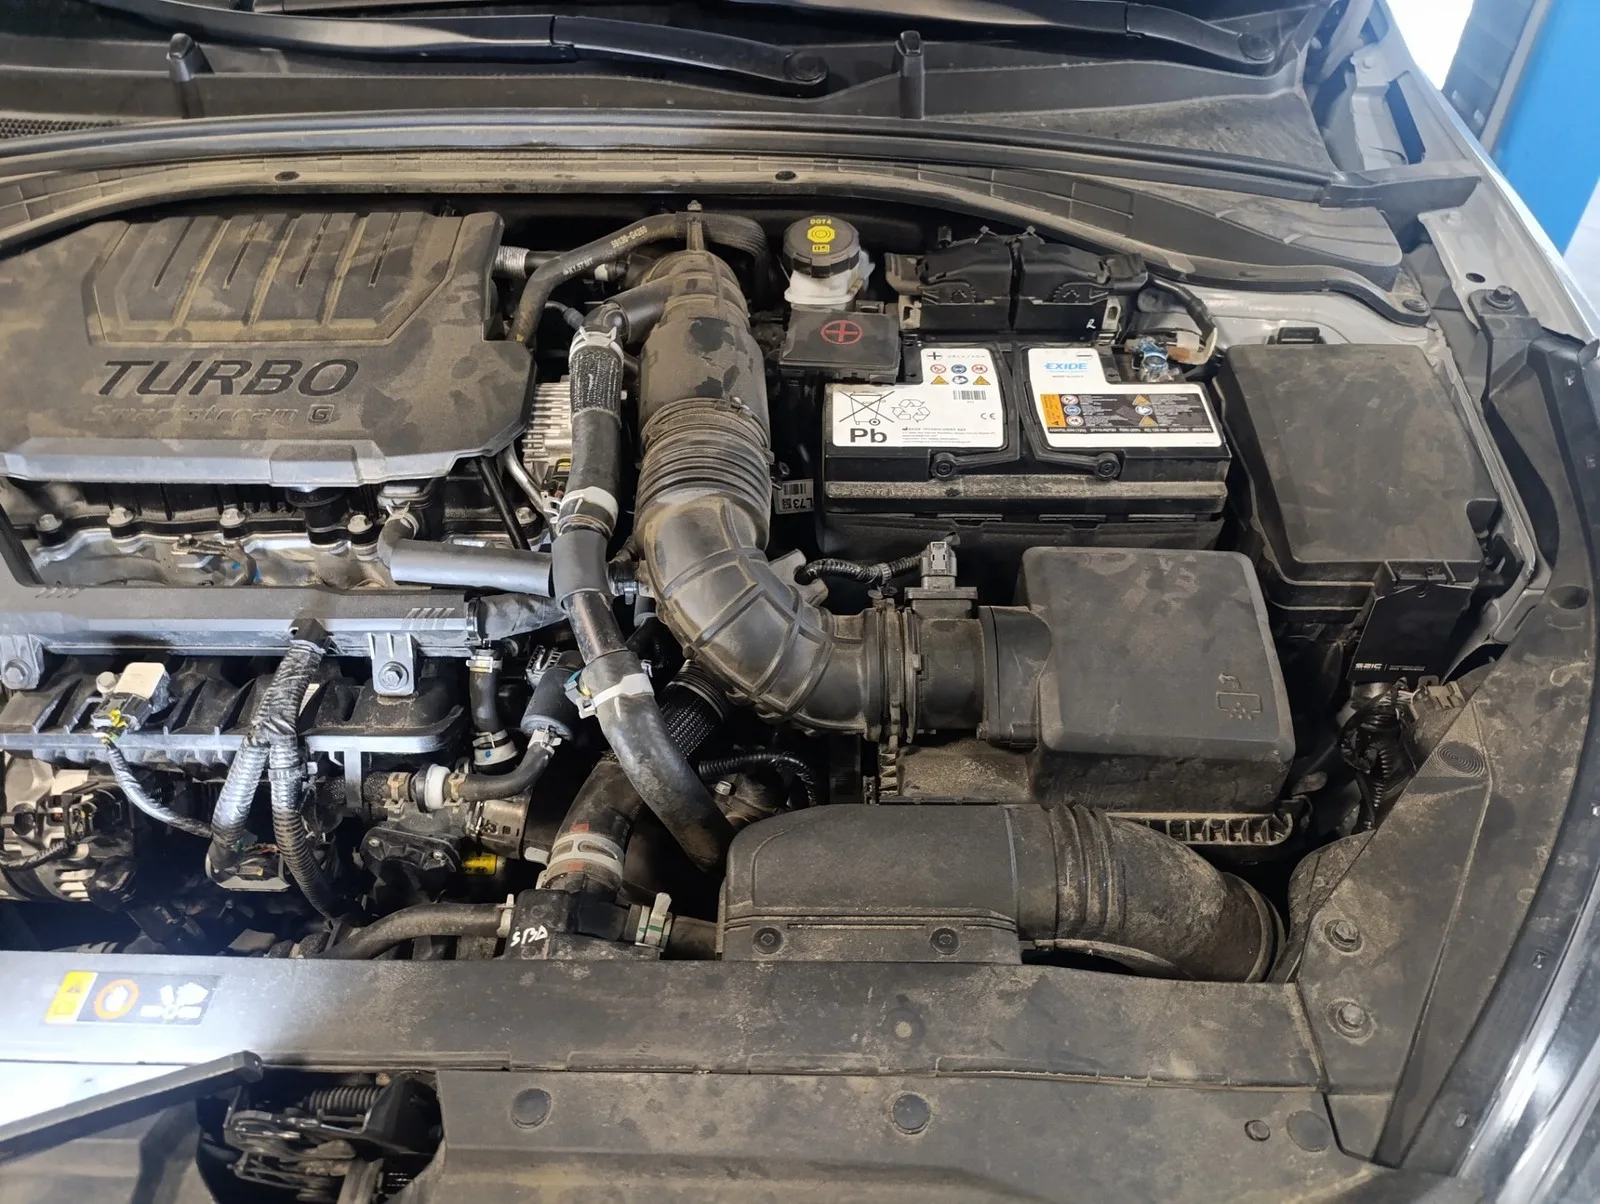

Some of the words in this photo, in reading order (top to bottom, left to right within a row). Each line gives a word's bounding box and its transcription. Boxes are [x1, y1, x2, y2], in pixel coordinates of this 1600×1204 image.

[1044, 362, 1088, 370] EXIDE
[98, 359, 359, 396] TURBO
[850, 428, 888, 444] Pb
[793, 497, 813, 509] L73
